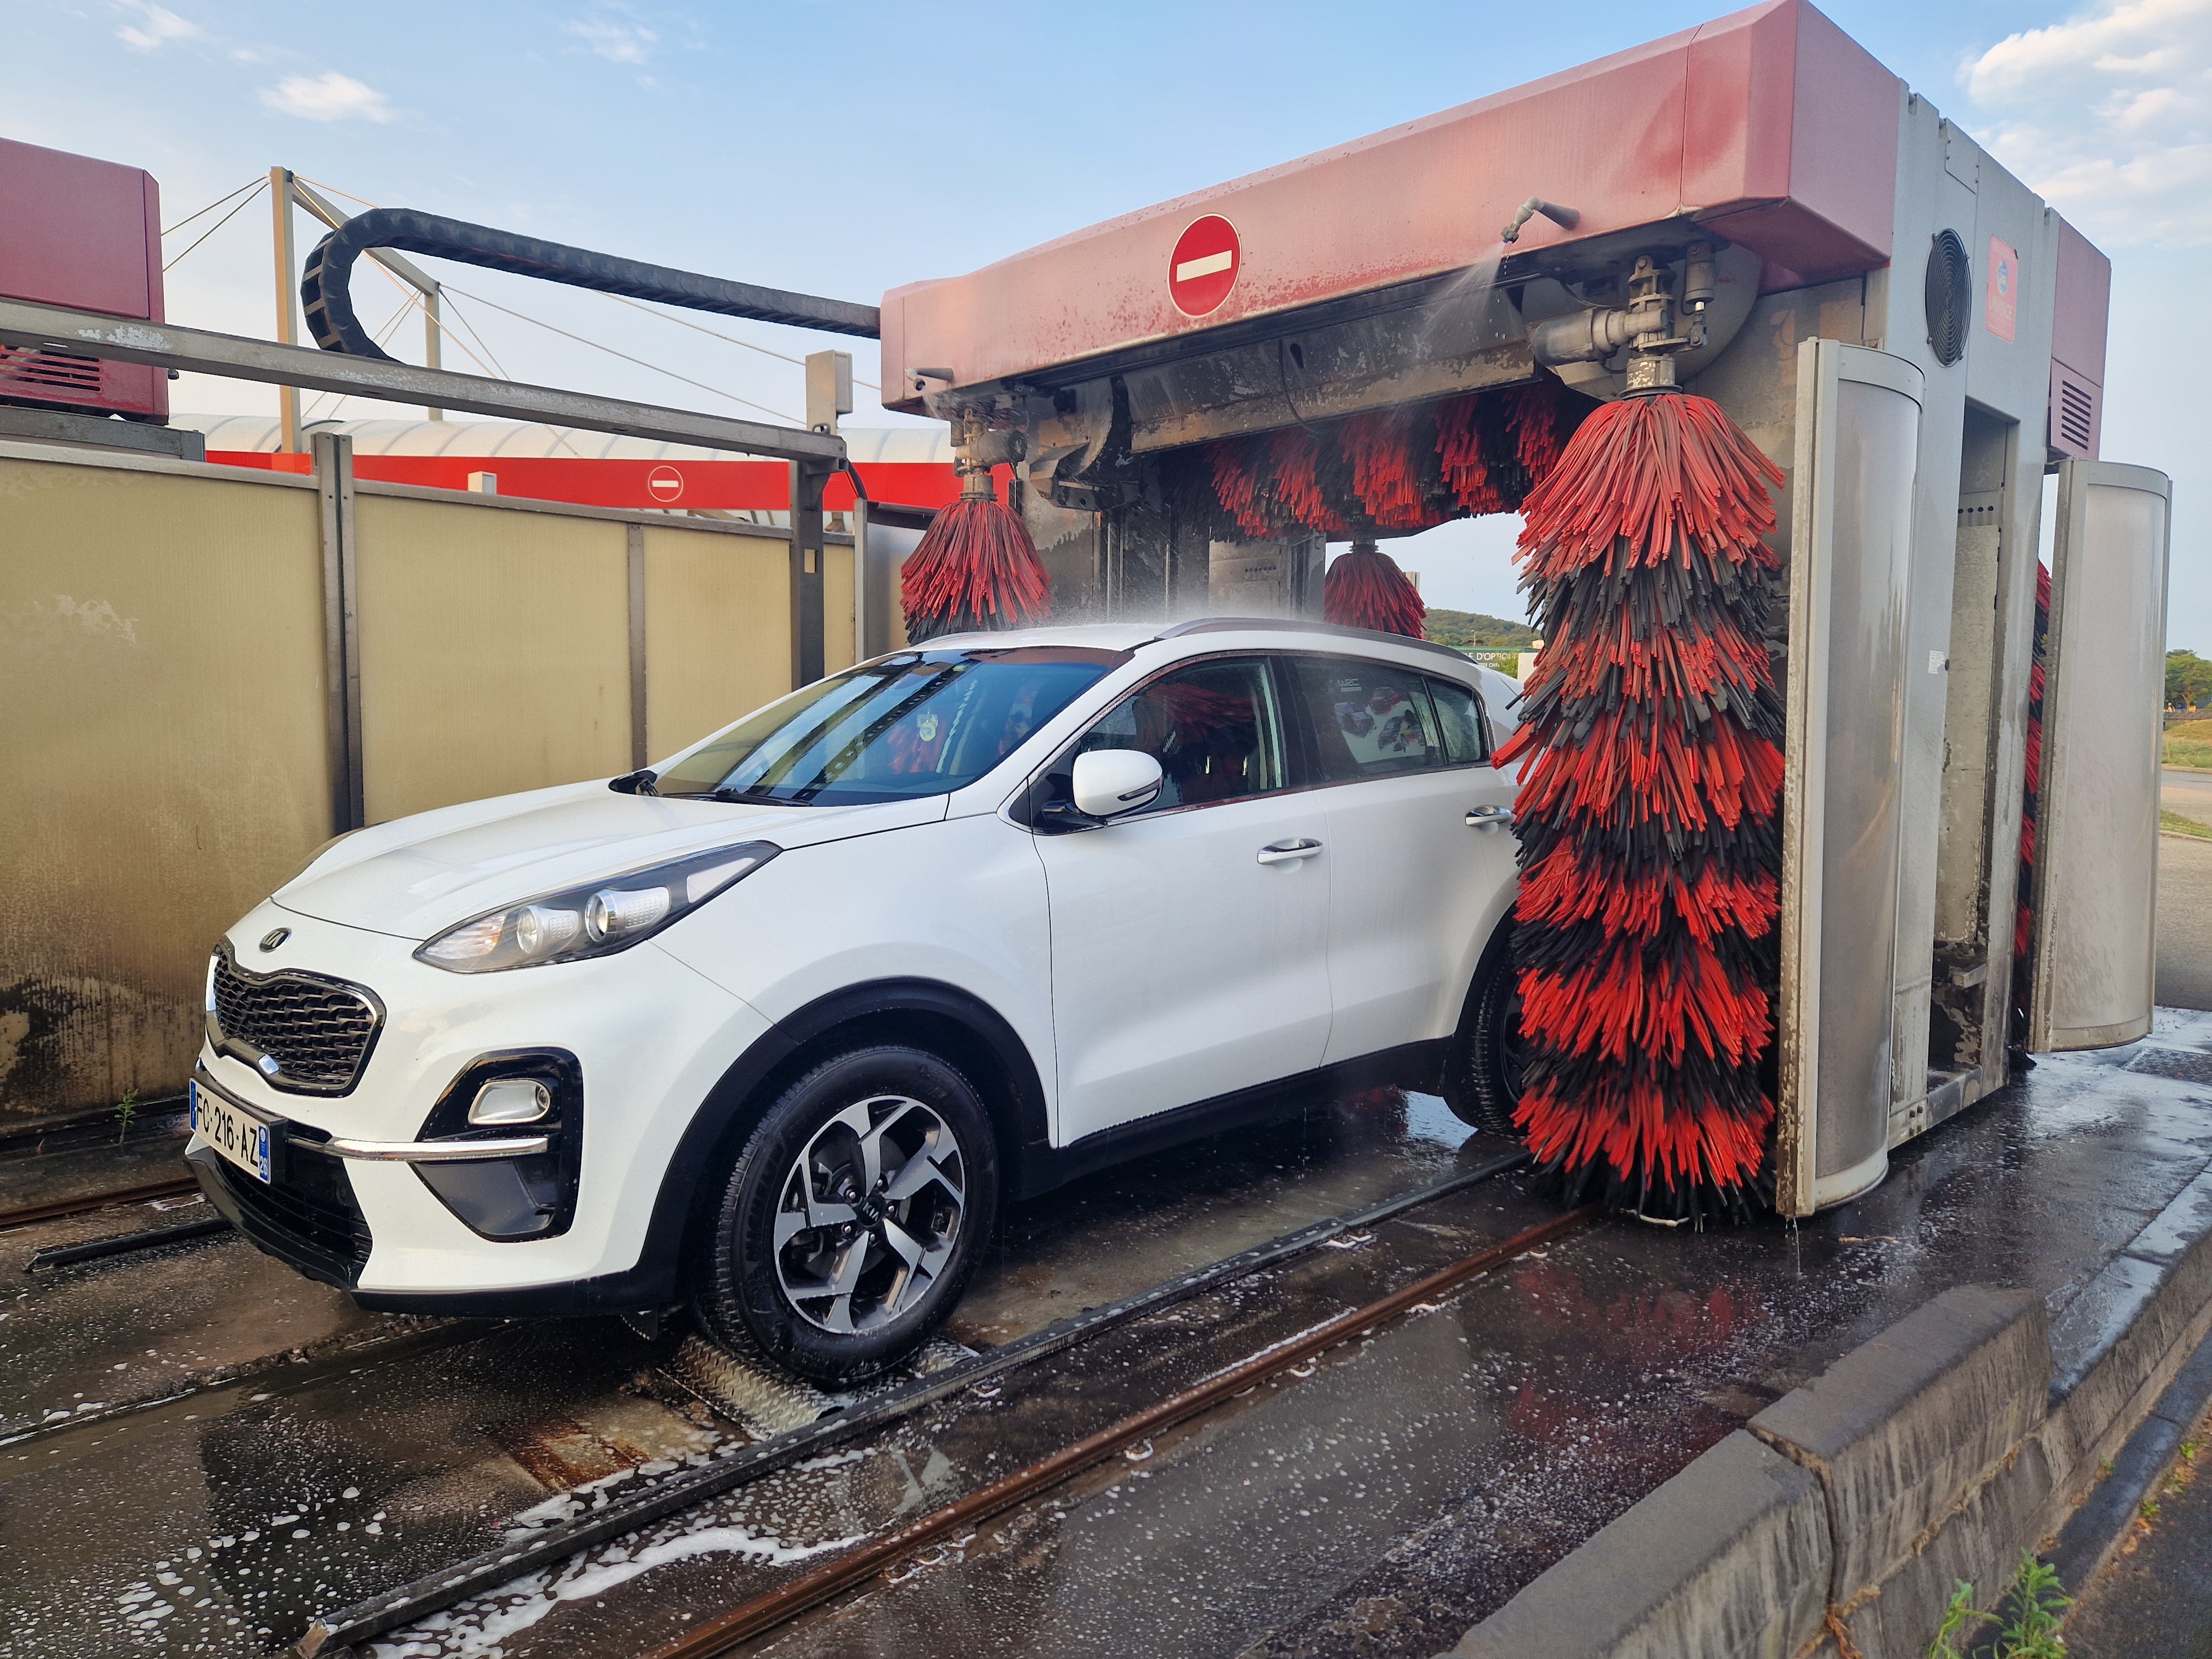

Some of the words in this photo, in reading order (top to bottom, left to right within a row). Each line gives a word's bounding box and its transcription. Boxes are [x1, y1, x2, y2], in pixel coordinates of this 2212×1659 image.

[197, 1091, 258, 1168] FC-216-AZ
[260, 1155, 268, 1176] 26
[862, 1202, 879, 1222] KIA
